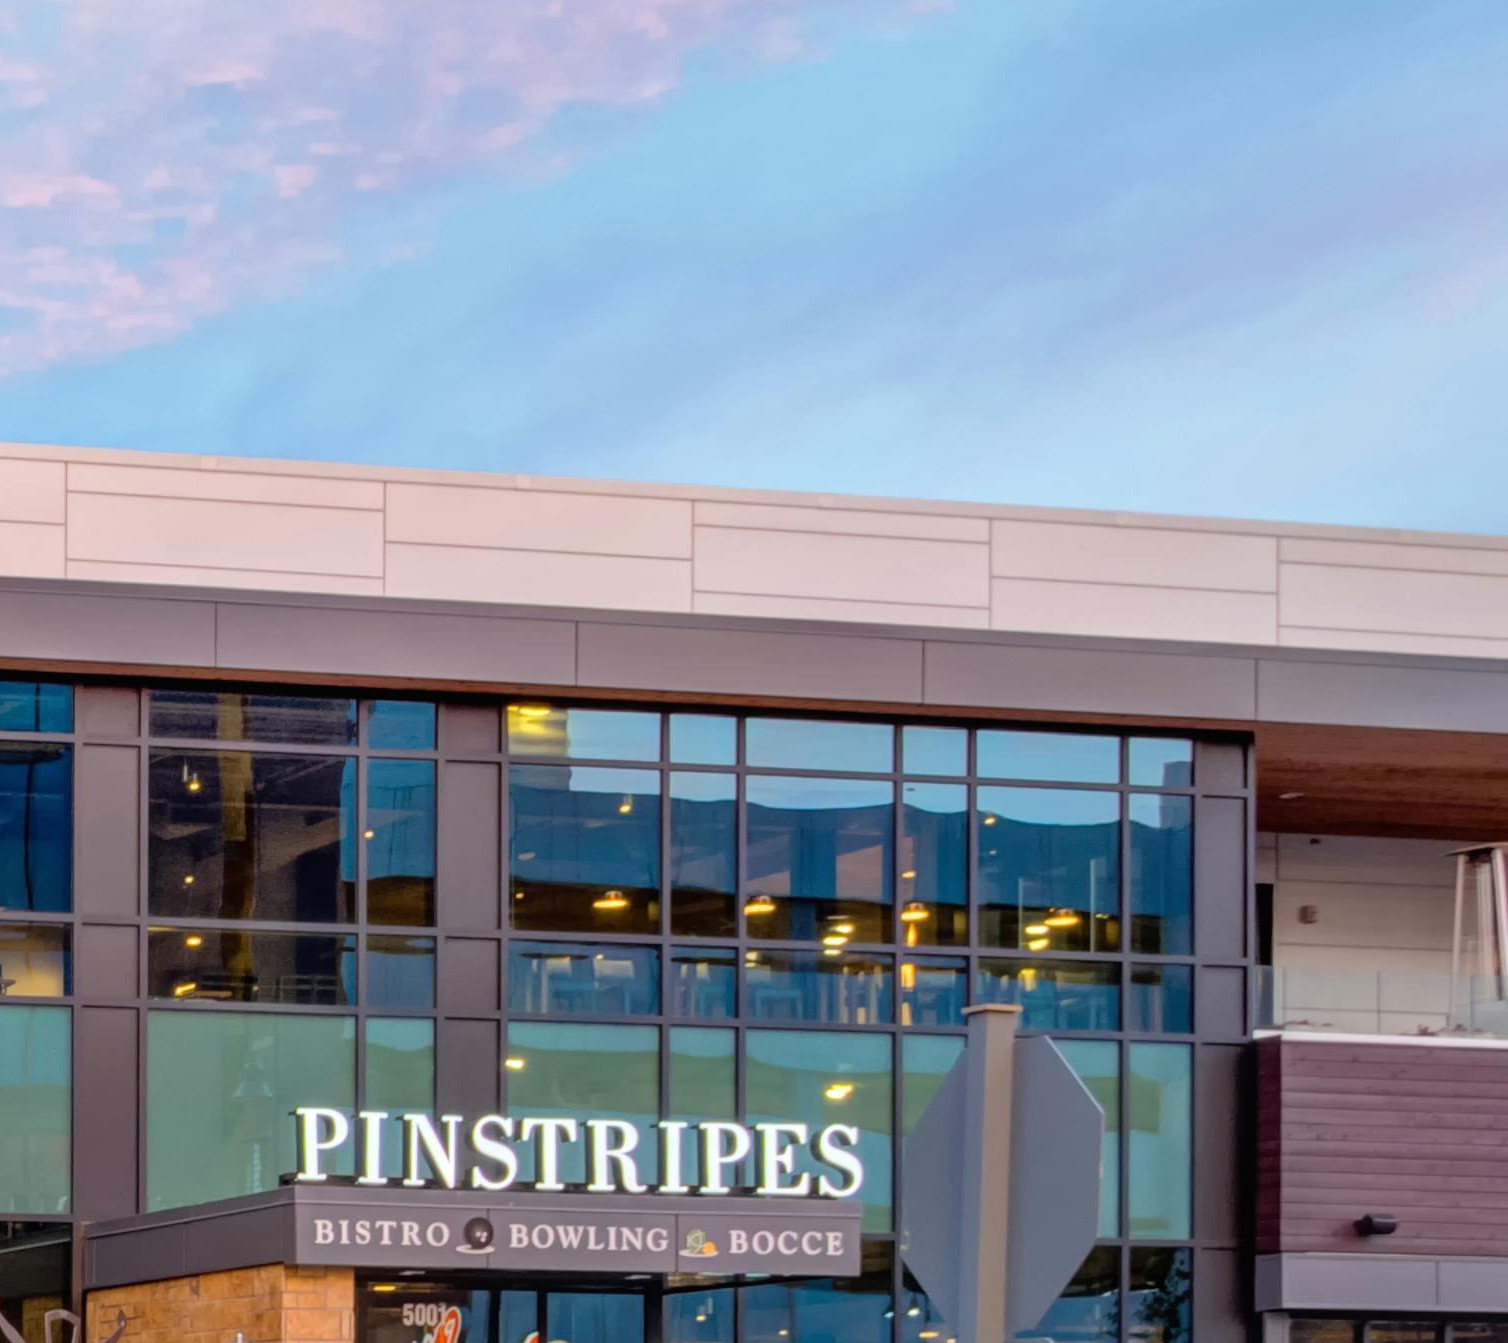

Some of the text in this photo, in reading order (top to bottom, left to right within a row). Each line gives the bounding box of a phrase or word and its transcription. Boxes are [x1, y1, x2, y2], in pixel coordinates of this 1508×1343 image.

[294, 1107, 864, 1198] PINSTRIPES
[314, 1218, 845, 1257] BISTRO BOWLING BOCCE
